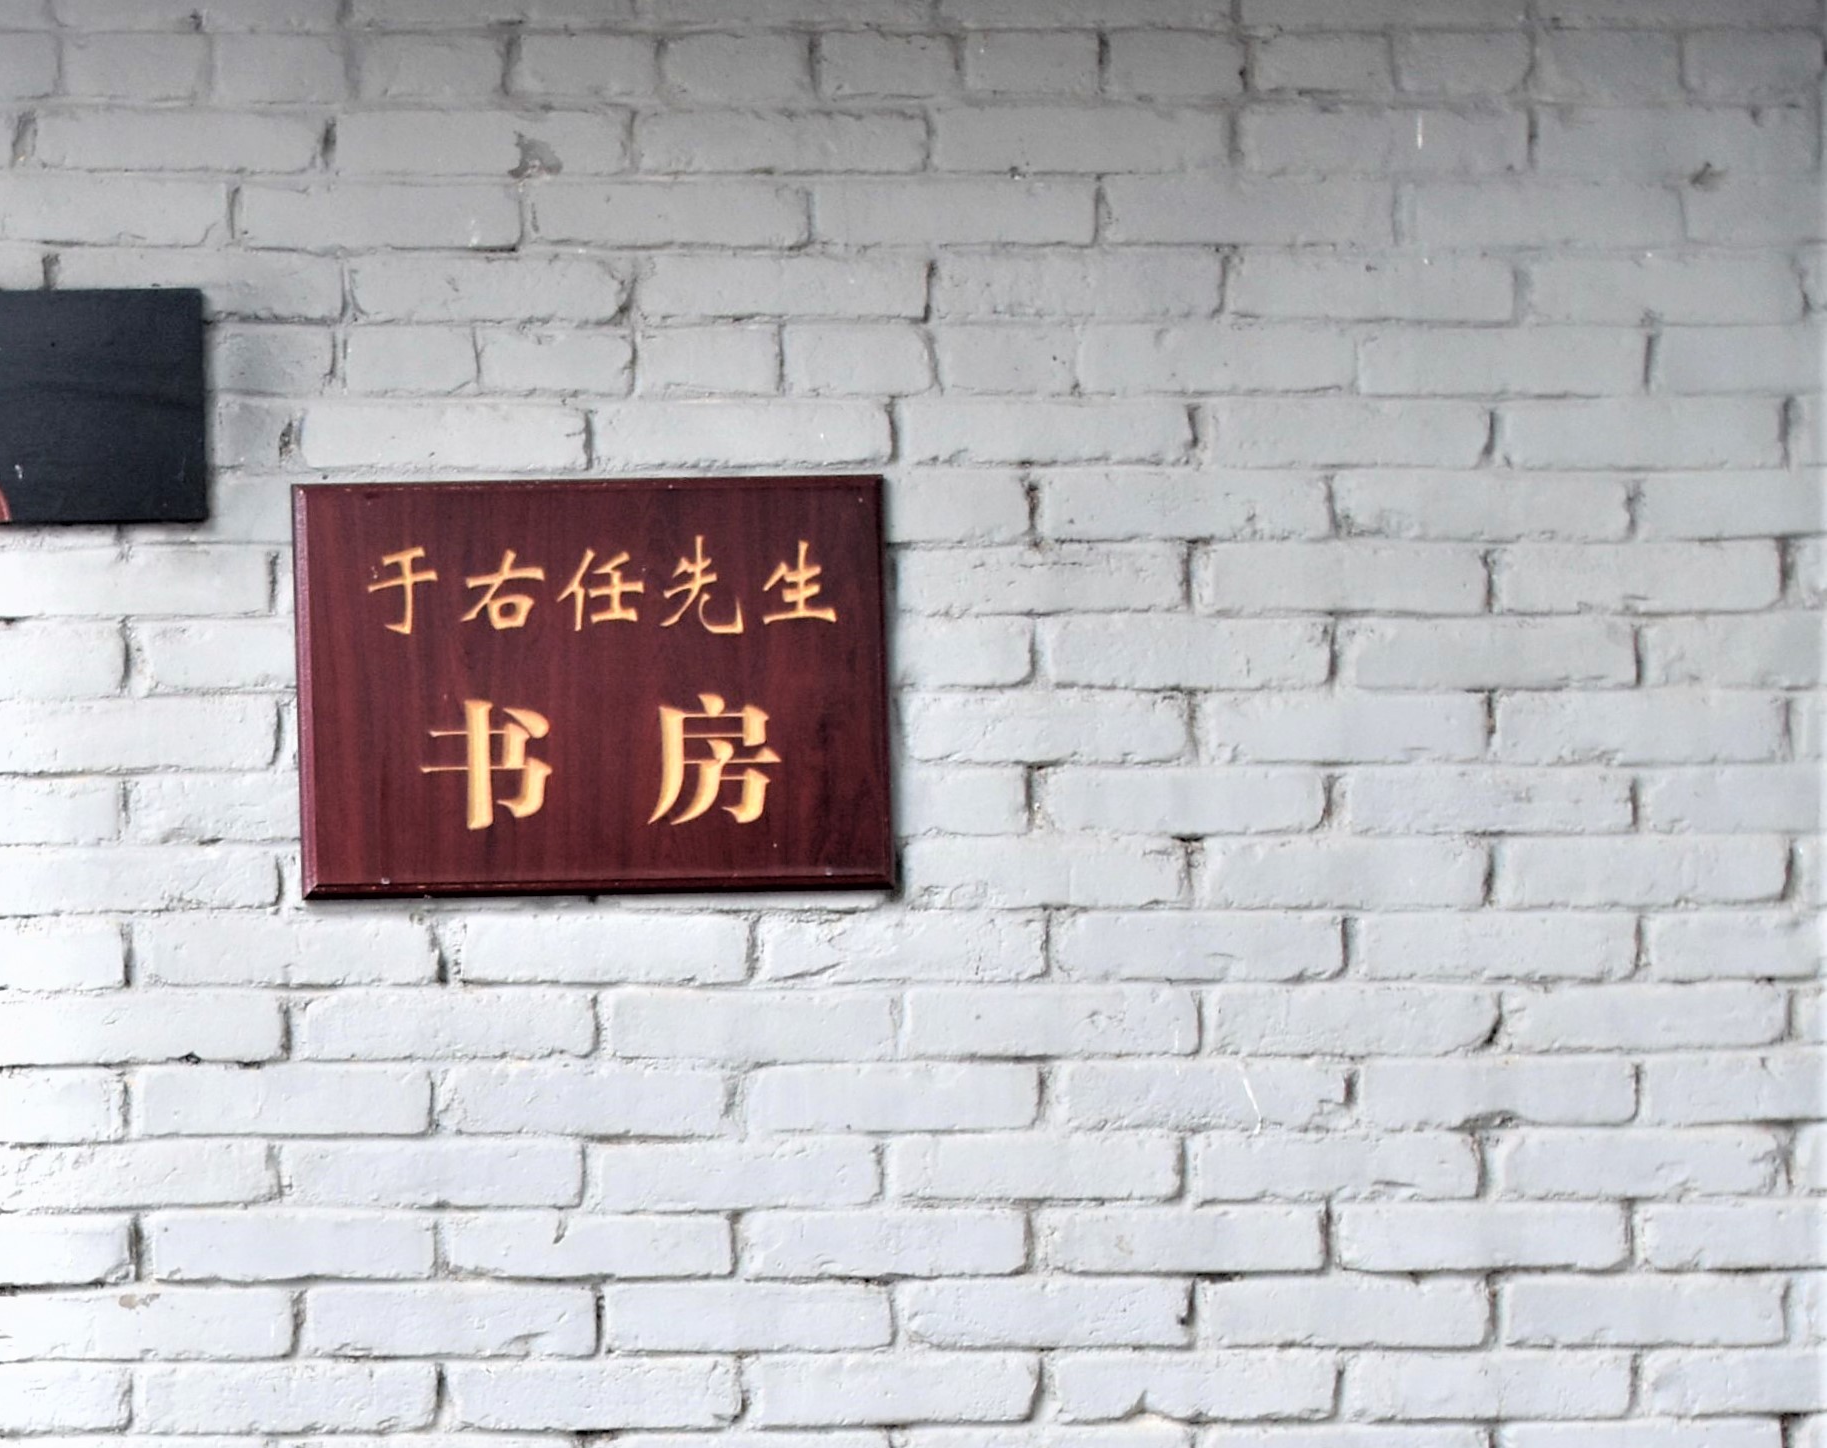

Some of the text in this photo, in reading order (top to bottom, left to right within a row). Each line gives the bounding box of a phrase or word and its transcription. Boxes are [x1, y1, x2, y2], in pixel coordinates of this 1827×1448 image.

[367, 535, 837, 635] 于右任先生
[419, 693, 782, 830] 书房
